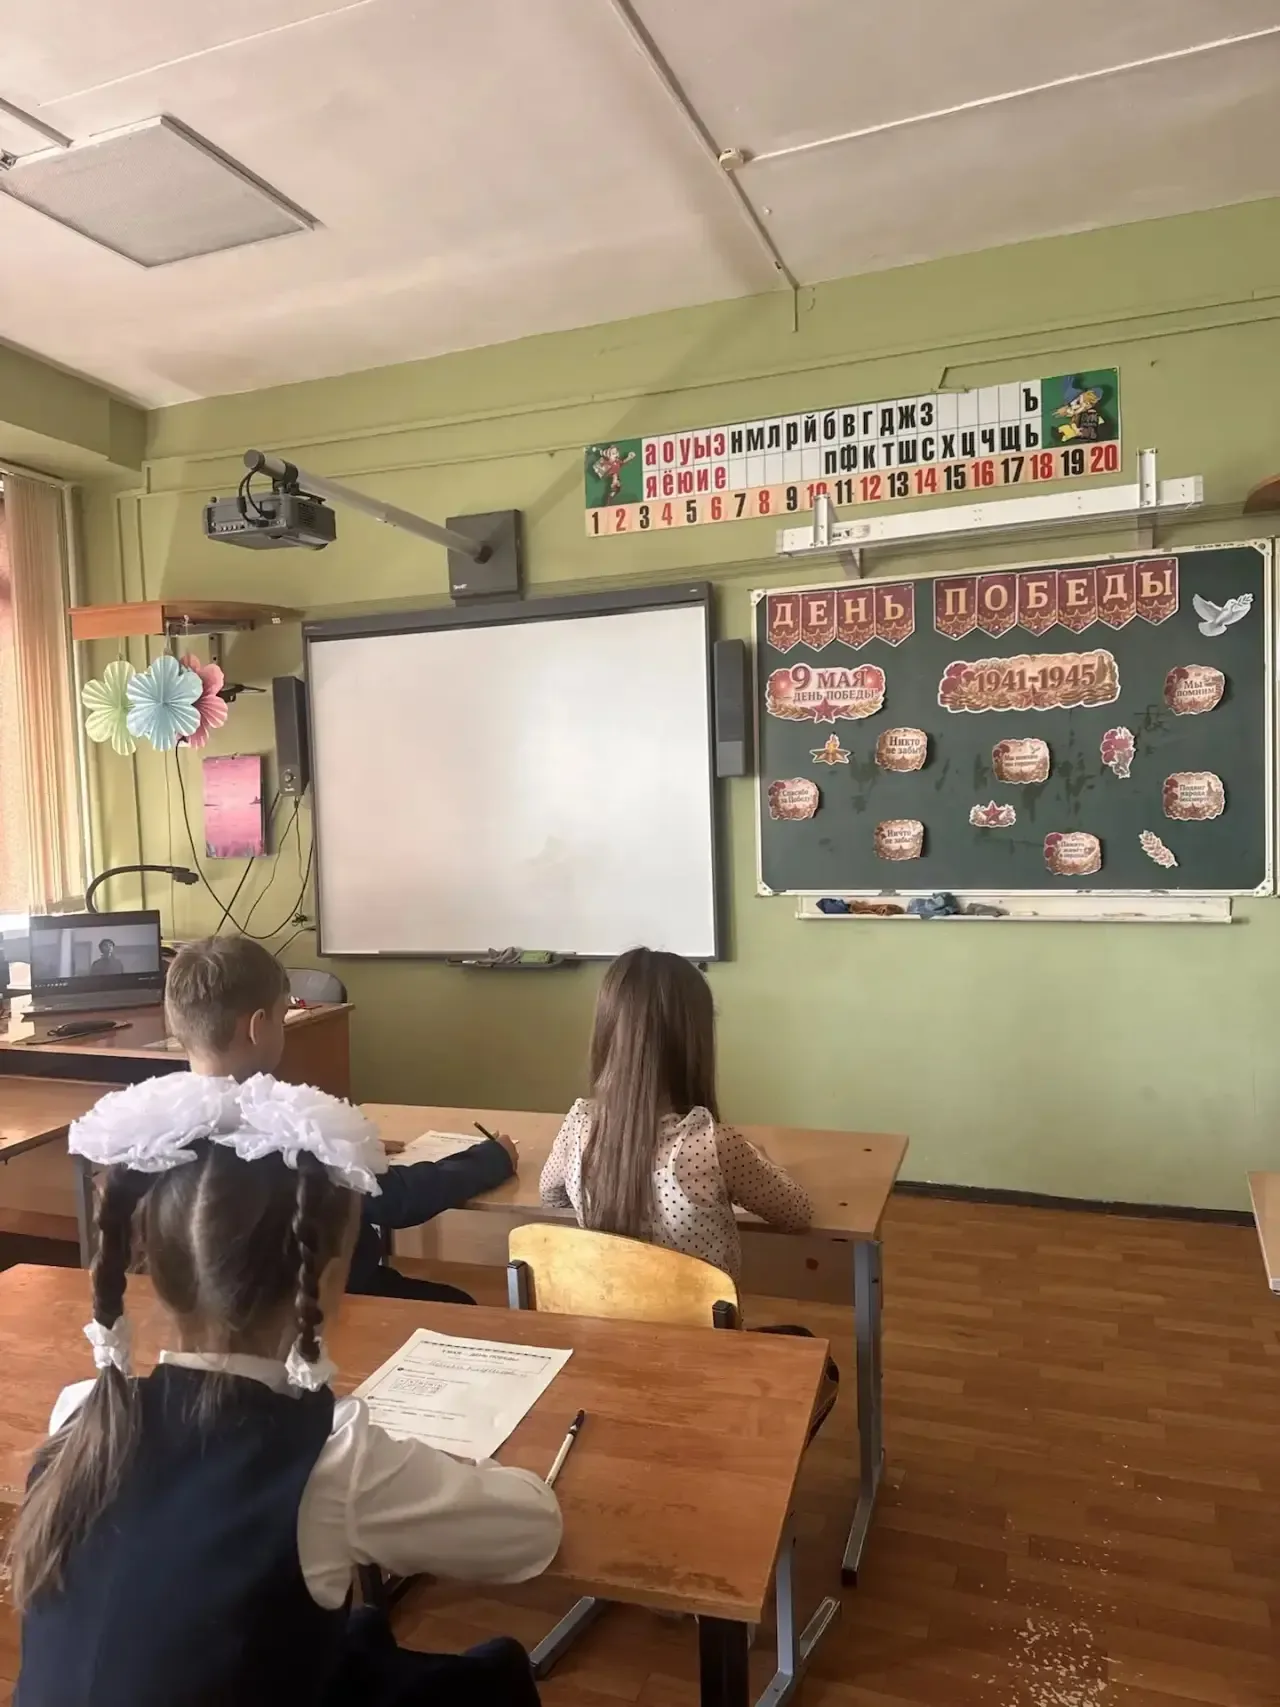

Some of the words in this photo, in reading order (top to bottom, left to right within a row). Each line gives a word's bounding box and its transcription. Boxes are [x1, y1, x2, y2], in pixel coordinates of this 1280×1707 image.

[591, 511, 600, 534] 1
[615, 508, 626, 532] 2
[639, 505, 650, 530] 3
[661, 502, 673, 526] 4
[686, 499, 697, 524] 5
[710, 496, 722, 520] 6
[734, 493, 746, 518] 7
[758, 490, 770, 515] 8
[786, 486, 798, 511] 9
[834, 478, 853, 505] 11
[860, 474, 882, 501] 12
[887, 471, 910, 498] 13
[914, 466, 938, 495] 14
[943, 464, 967, 491] 15
[970, 459, 994, 487] 16
[1000, 456, 1025, 484] 17
[1028, 452, 1053, 481] 18
[1060, 448, 1085, 476] 19
[1090, 443, 1118, 473] 20
[773, 595, 904, 629] ДЕНЬ
[944, 570, 1173, 615] ПОБЕДЫ
[791, 666, 811, 690] 9
[817, 671, 865, 689] МАЯ
[976, 664, 1096, 693] 1941-1945
[1184, 681, 1202, 689] Мы
[794, 690, 823, 702] ДЕНЬ
[890, 736, 920, 746] Никто
